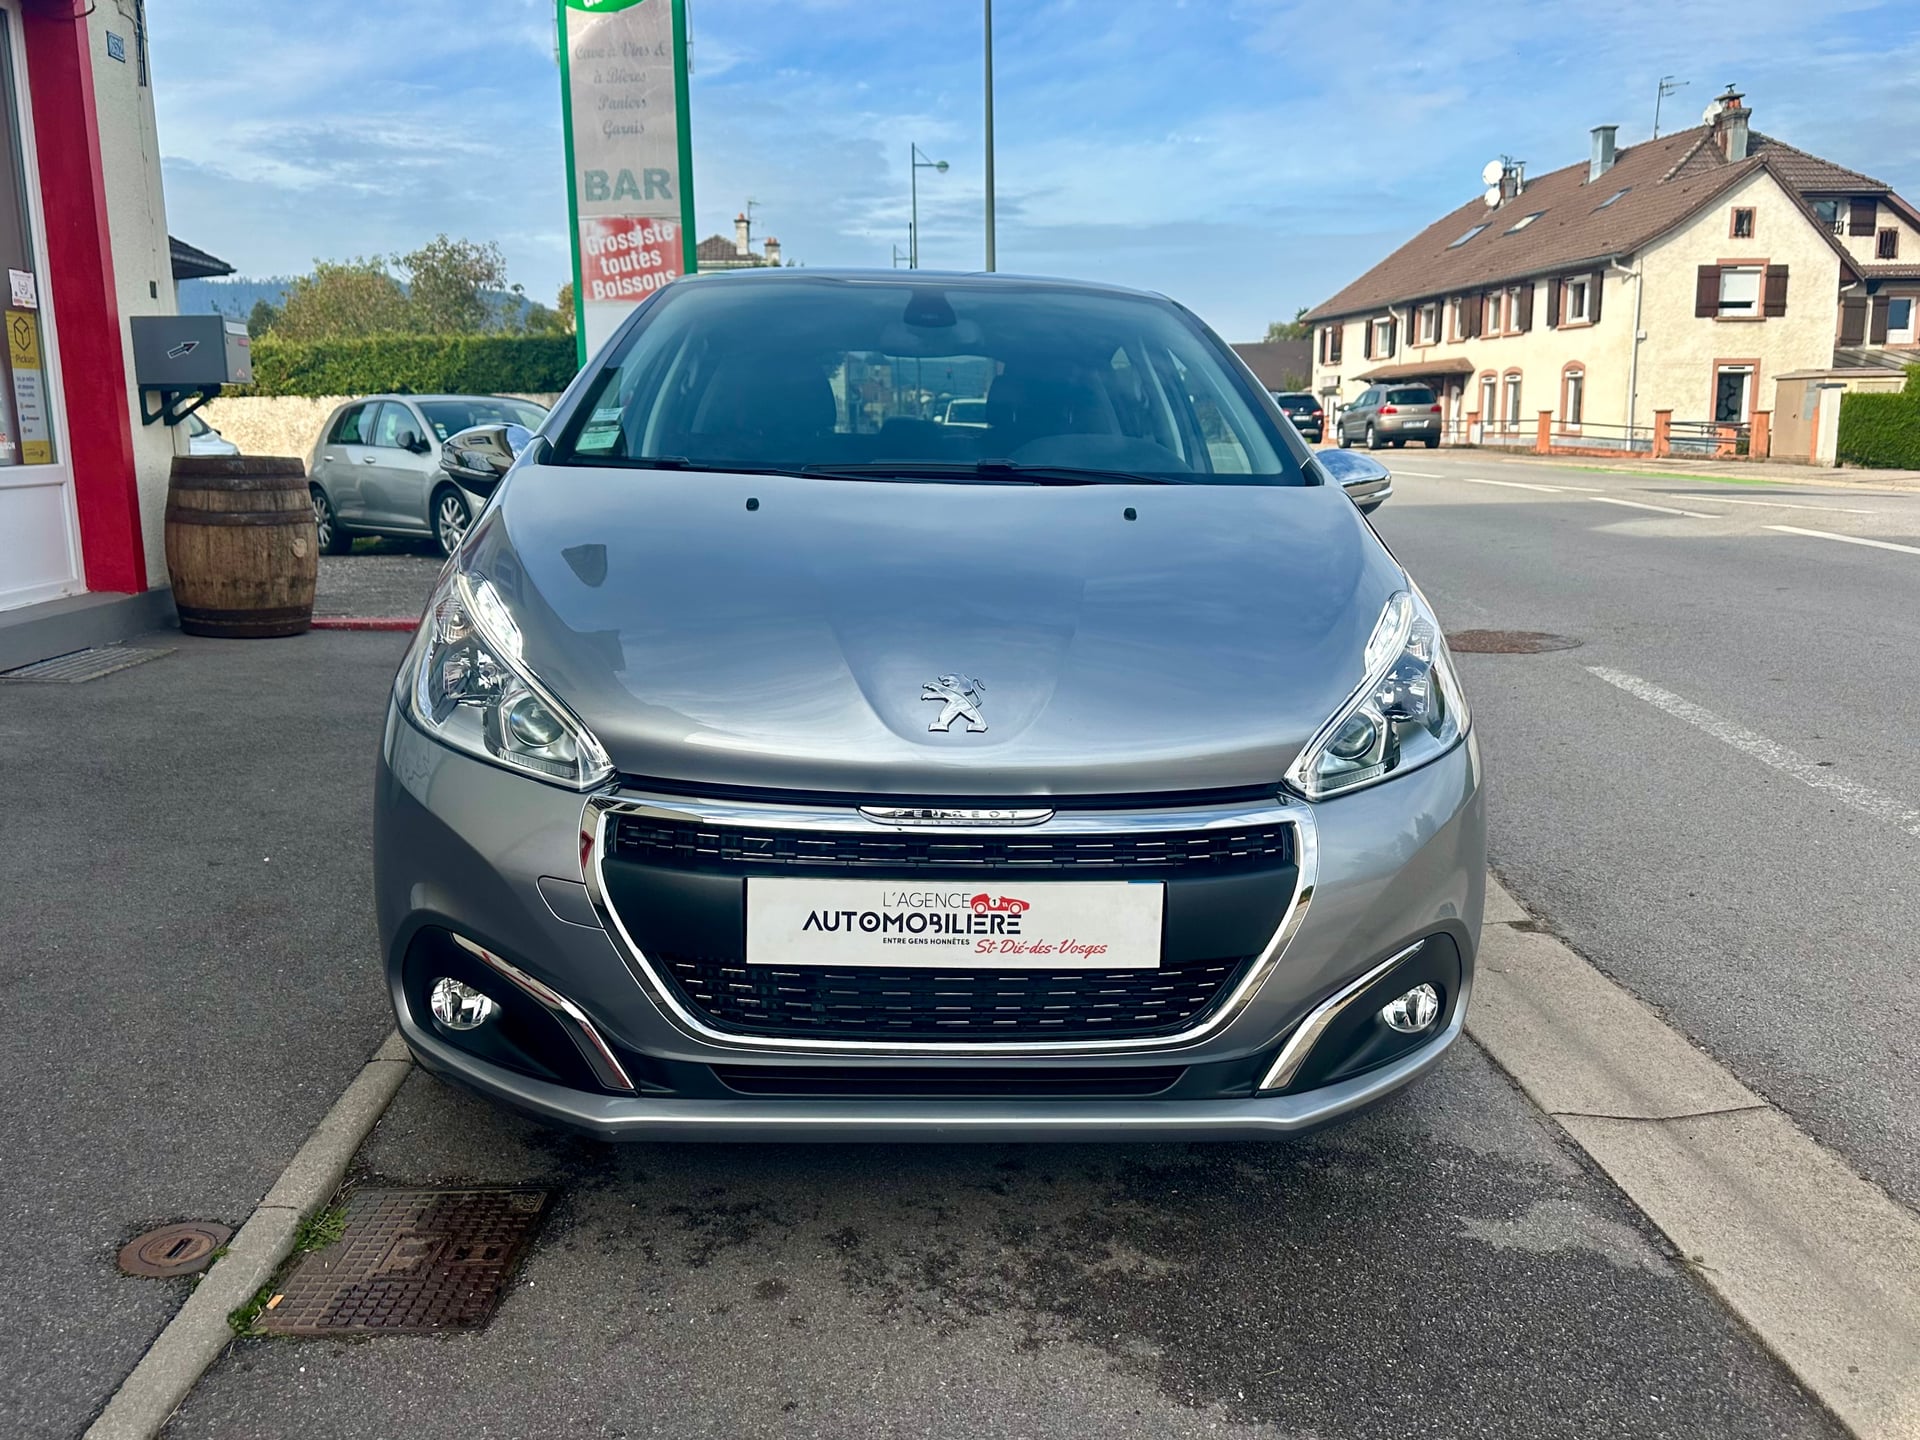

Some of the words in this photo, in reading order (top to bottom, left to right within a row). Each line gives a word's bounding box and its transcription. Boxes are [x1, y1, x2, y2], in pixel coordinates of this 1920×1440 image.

[622, 41, 649, 58] Vins
[598, 94, 647, 111] Paniers
[602, 119, 645, 139] Garnis
[584, 168, 673, 202] BAR
[586, 222, 675, 256] Grossiste
[600, 249, 662, 276] toutes
[882, 892, 972, 909] L'AGENCE
[882, 937, 906, 945] ENTRE
[907, 937, 928, 945] GENS
[930, 936, 970, 946] HONNÊTES
[974, 938, 1108, 960] St-Dié-des-Vosges
